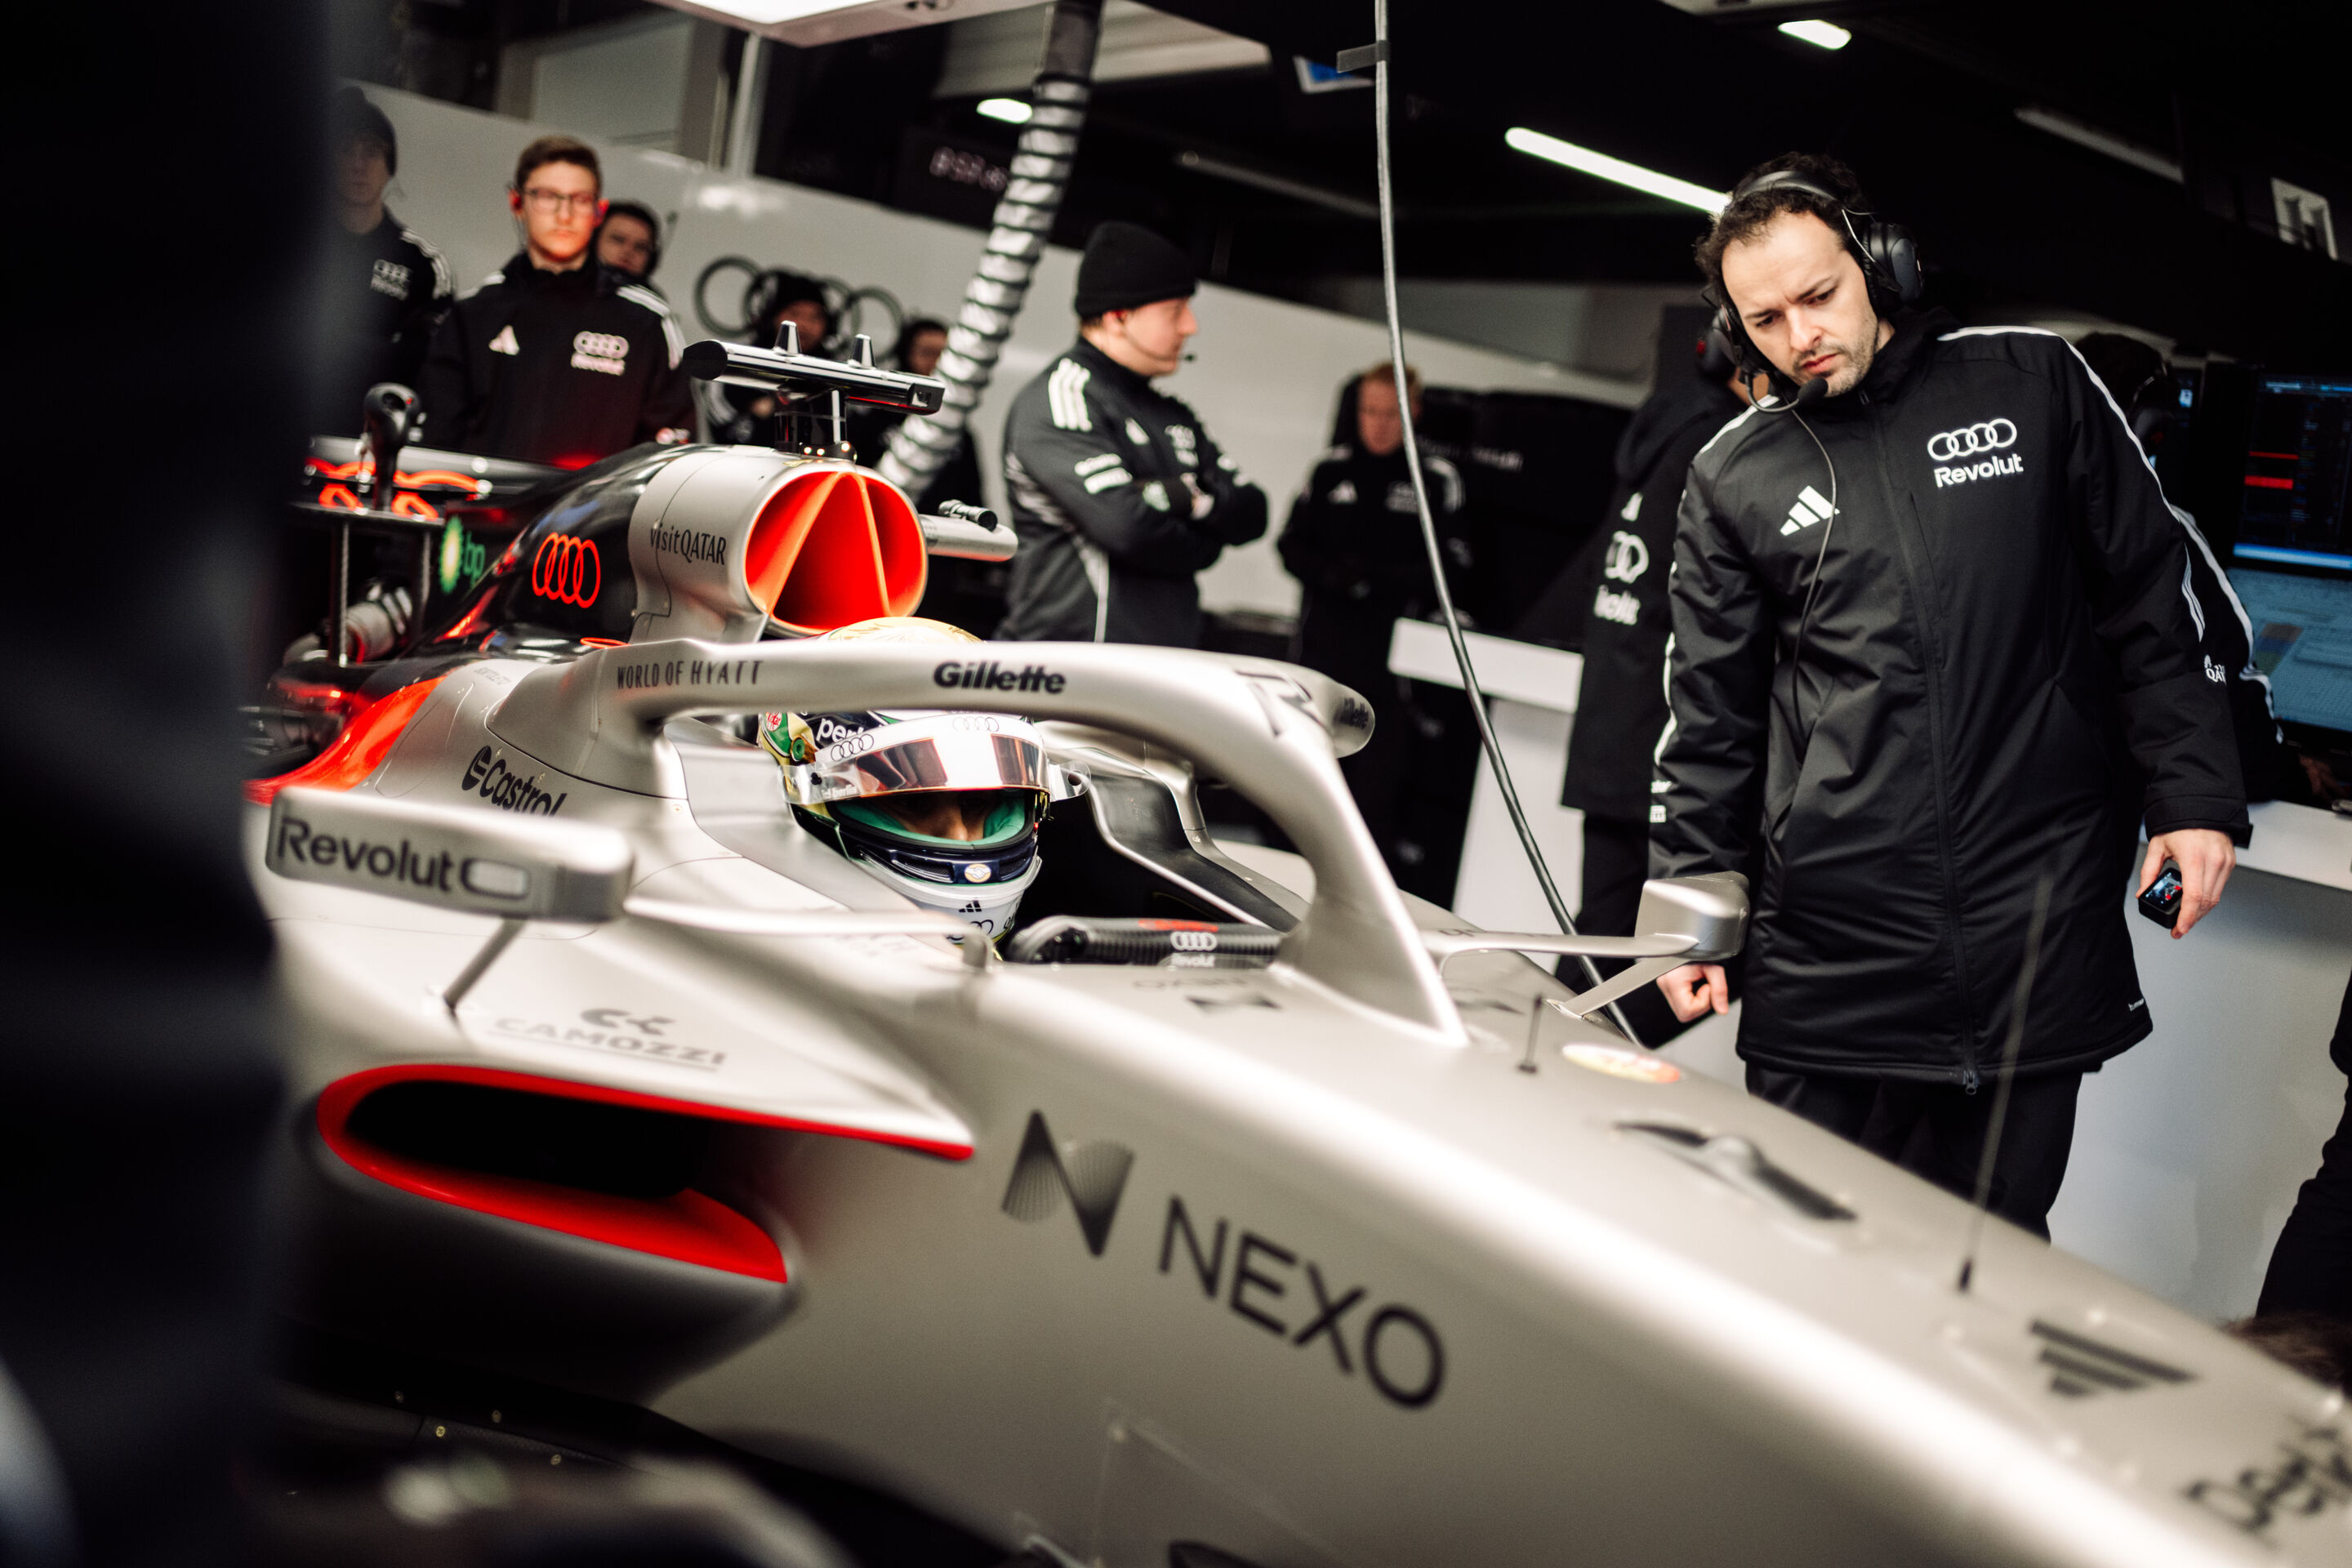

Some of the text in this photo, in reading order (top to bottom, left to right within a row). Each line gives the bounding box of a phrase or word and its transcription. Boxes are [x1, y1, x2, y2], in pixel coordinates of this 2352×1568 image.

[1933, 453, 2024, 488] Revolut
[463, 530, 485, 588] bp
[650, 523, 727, 565] visitQATAR
[617, 660, 764, 689] WORLD OF HYATT
[933, 660, 1067, 694] Gillette
[479, 759, 568, 817] Castrol
[278, 817, 453, 892] Revolut
[494, 1017, 726, 1065] CAMOZZI
[1158, 1193, 1447, 1410] NEXO
